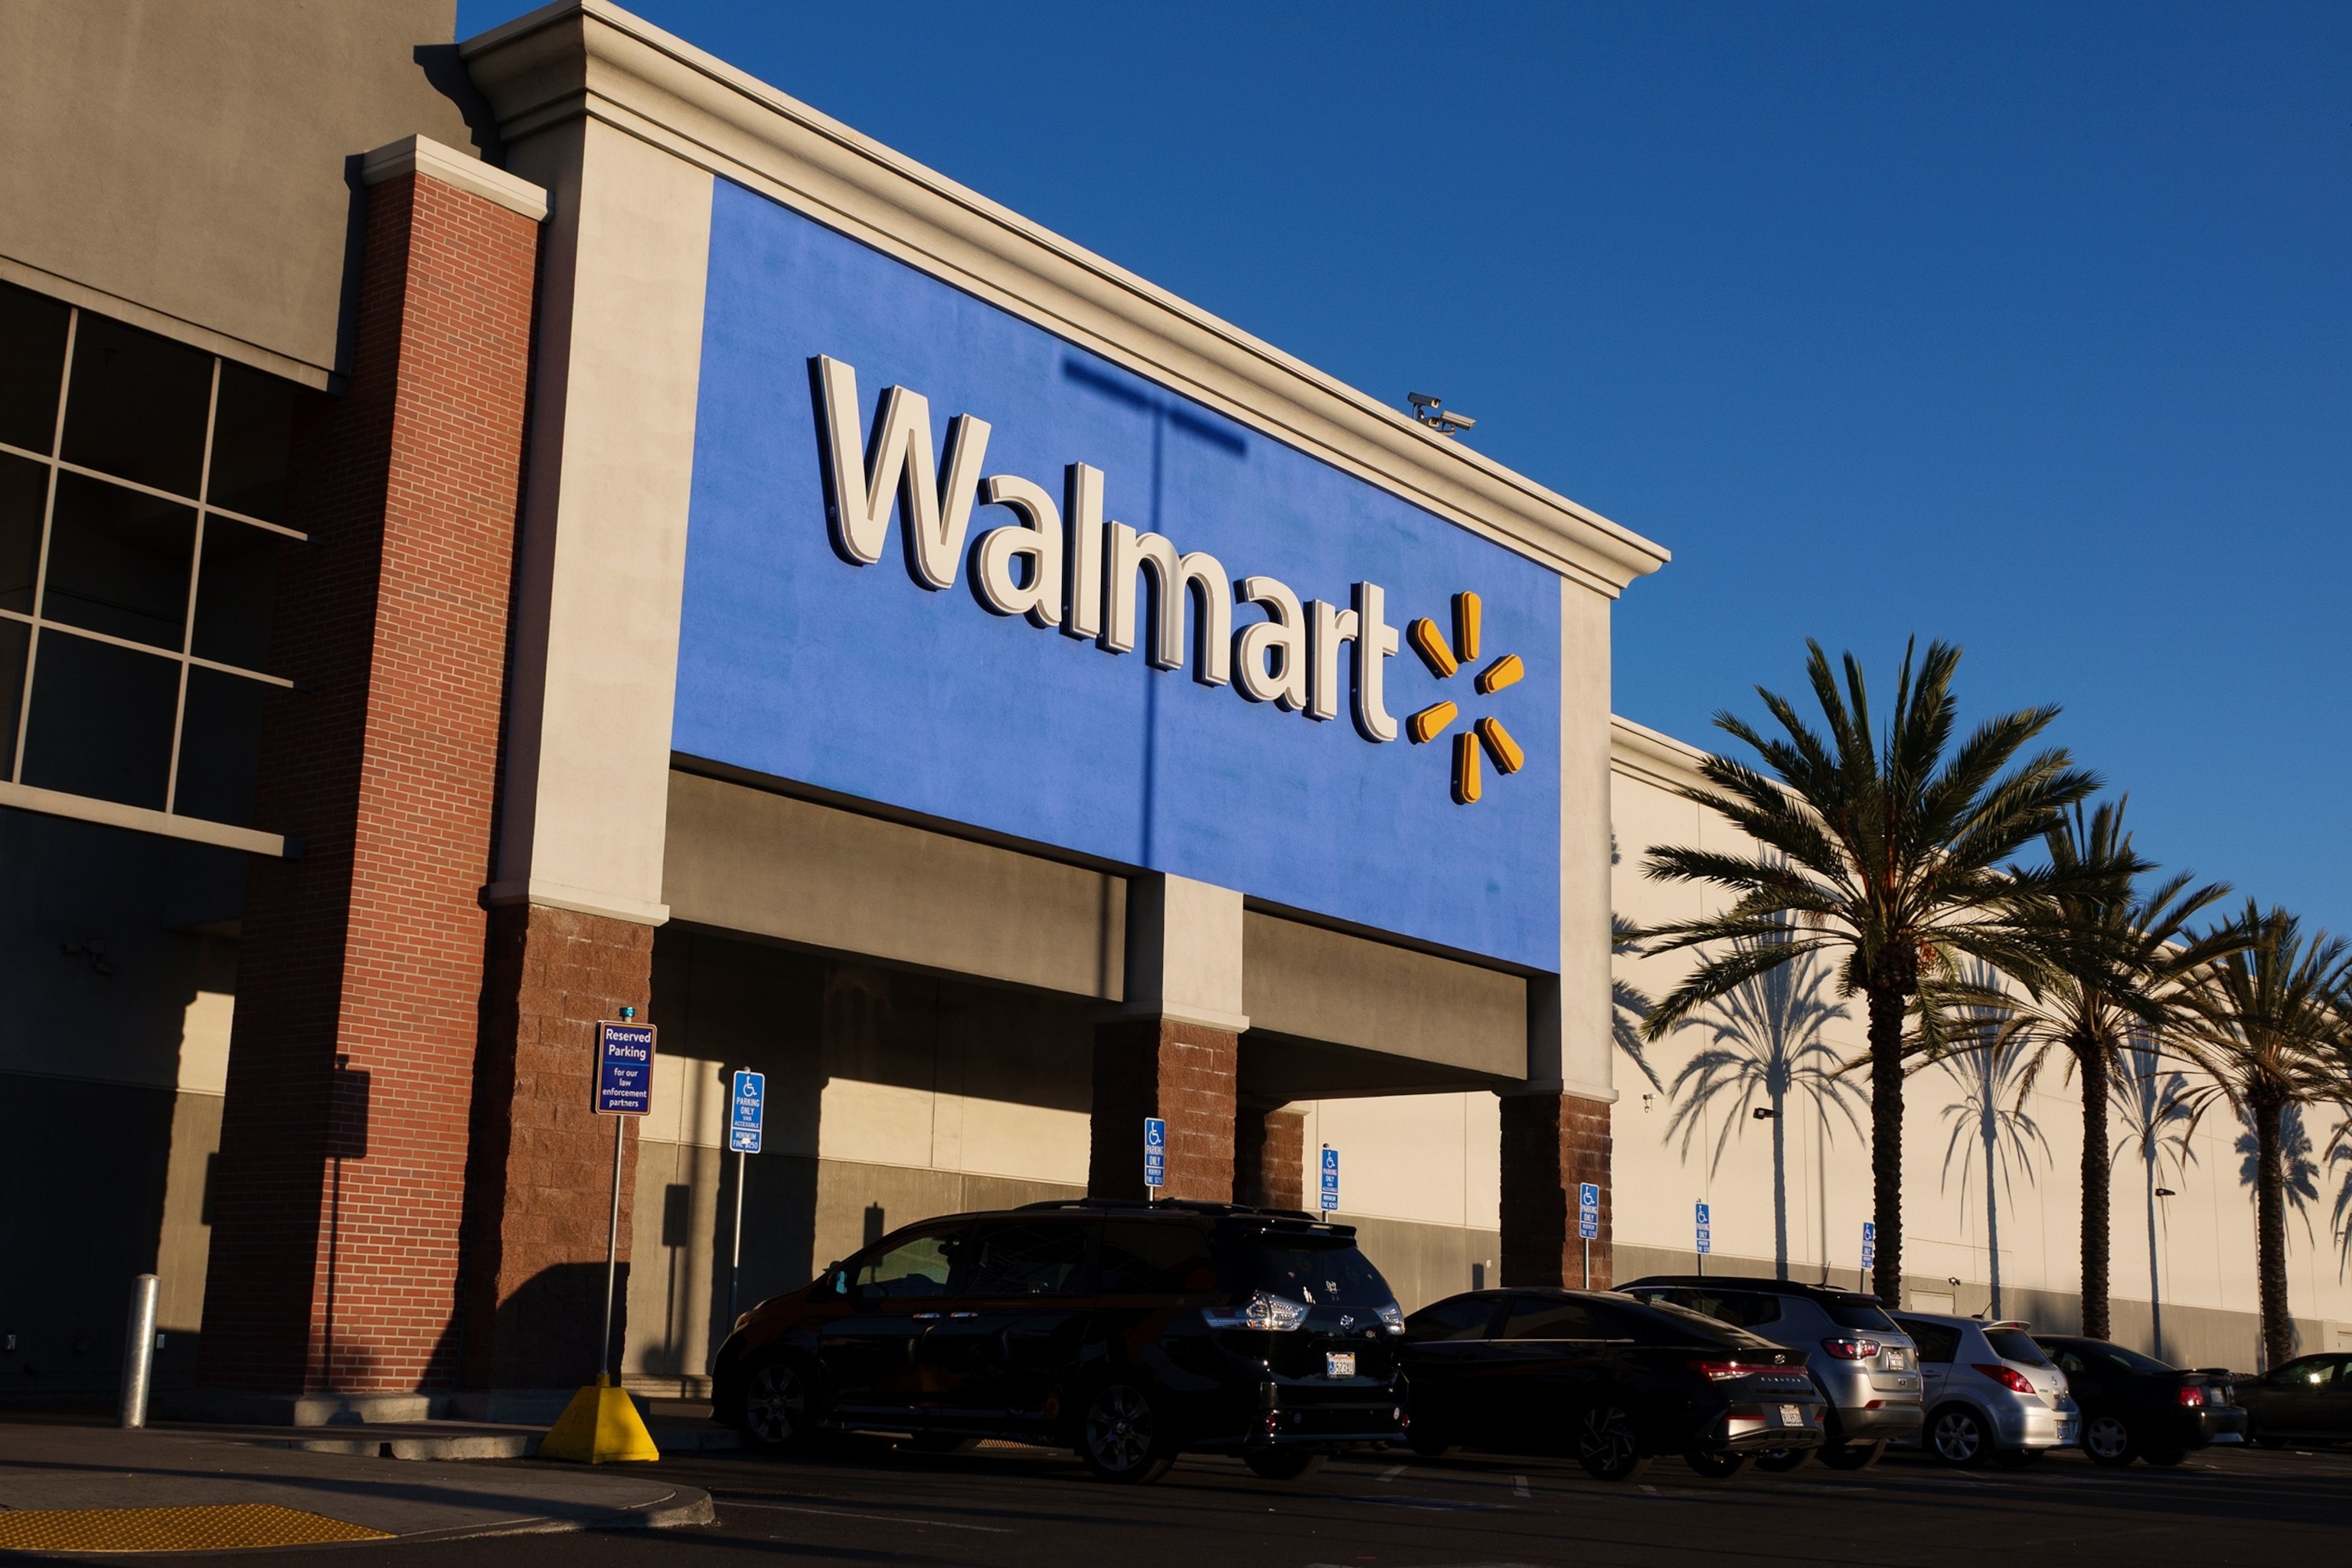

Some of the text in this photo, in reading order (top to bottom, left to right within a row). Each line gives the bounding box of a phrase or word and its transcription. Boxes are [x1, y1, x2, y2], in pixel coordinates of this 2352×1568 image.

[815, 353, 1399, 743] Walmart
[606, 1028, 652, 1043] Reserved
[609, 1044, 646, 1061] Parking
[614, 1068, 625, 1076] for
[619, 1078, 632, 1086] law
[603, 1088, 647, 1098] enforcement
[609, 1099, 639, 1108] partners
[736, 1096, 760, 1107] PARKING
[740, 1106, 755, 1116] ONLY
[734, 1120, 760, 1129] ACCESSIBLE
[1147, 1145, 1164, 1155] PARKING
[1149, 1155, 1161, 1165] ONLY
[1582, 1204, 1597, 1214] PARKING
